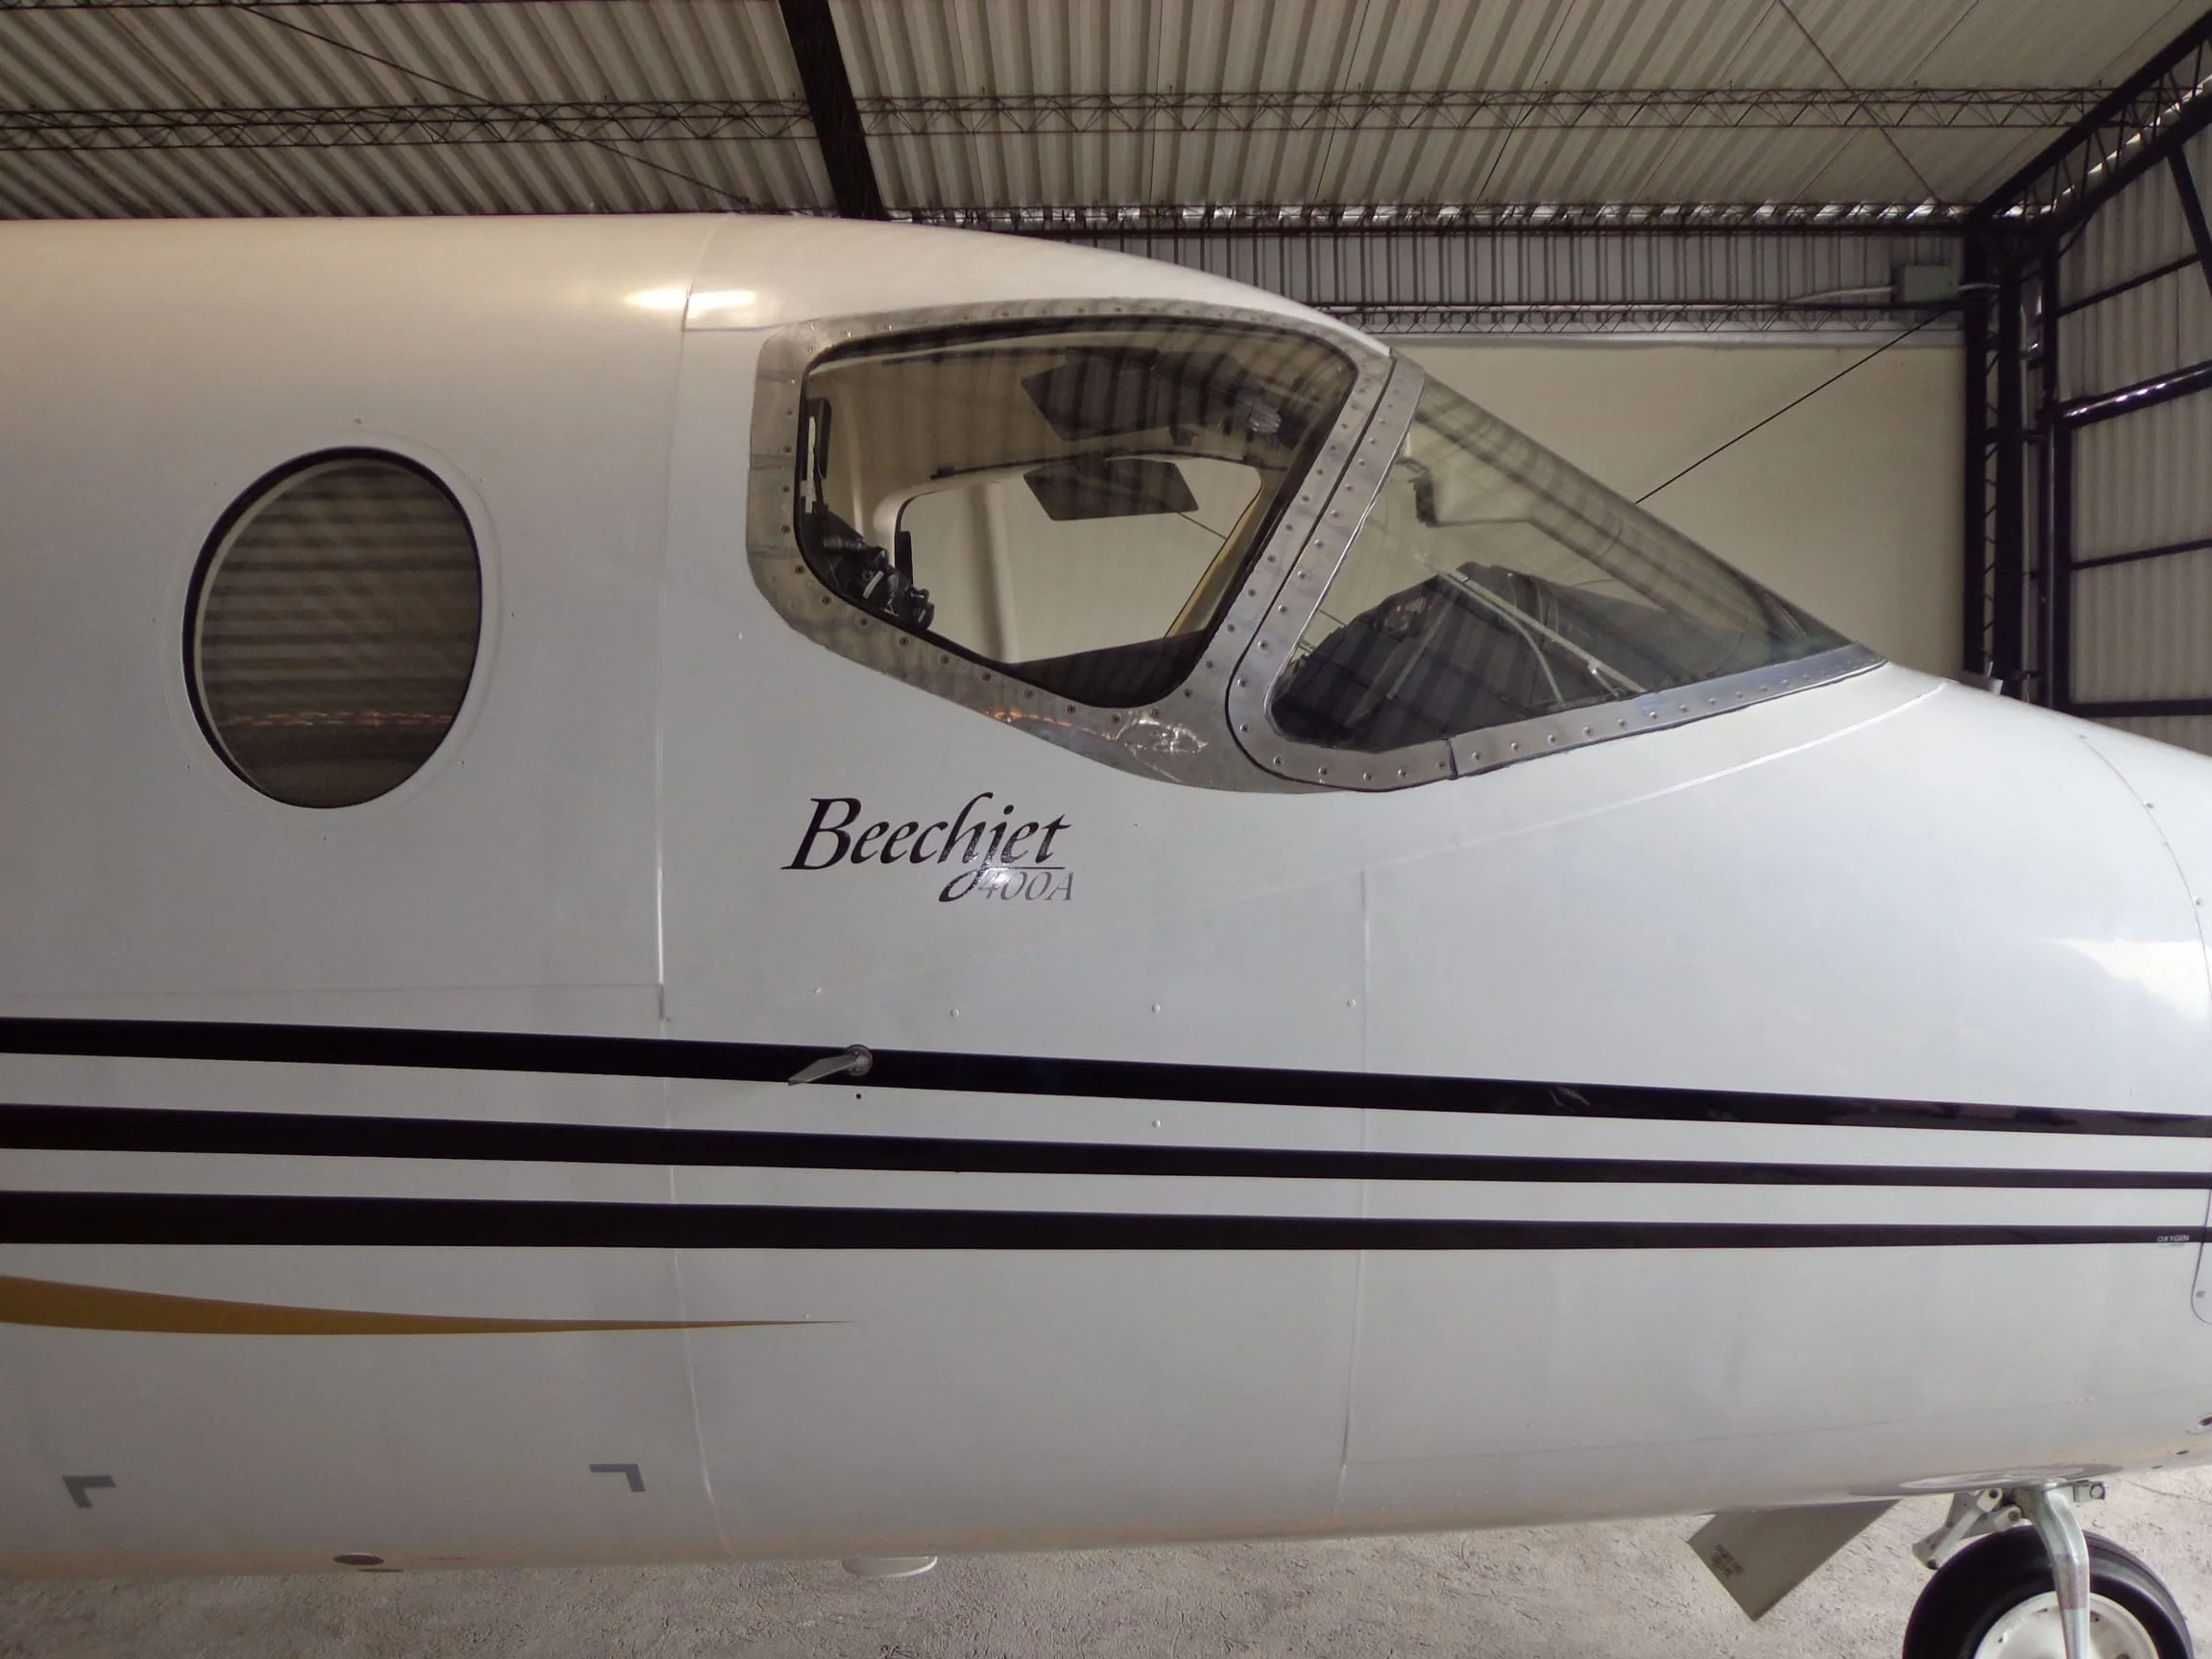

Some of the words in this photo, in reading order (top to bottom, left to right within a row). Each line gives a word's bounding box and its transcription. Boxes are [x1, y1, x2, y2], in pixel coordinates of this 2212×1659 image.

[781, 792, 1071, 902] Beechjet
[978, 871, 1074, 901] 400A
[2157, 1235, 2190, 1243] OXYGEN
